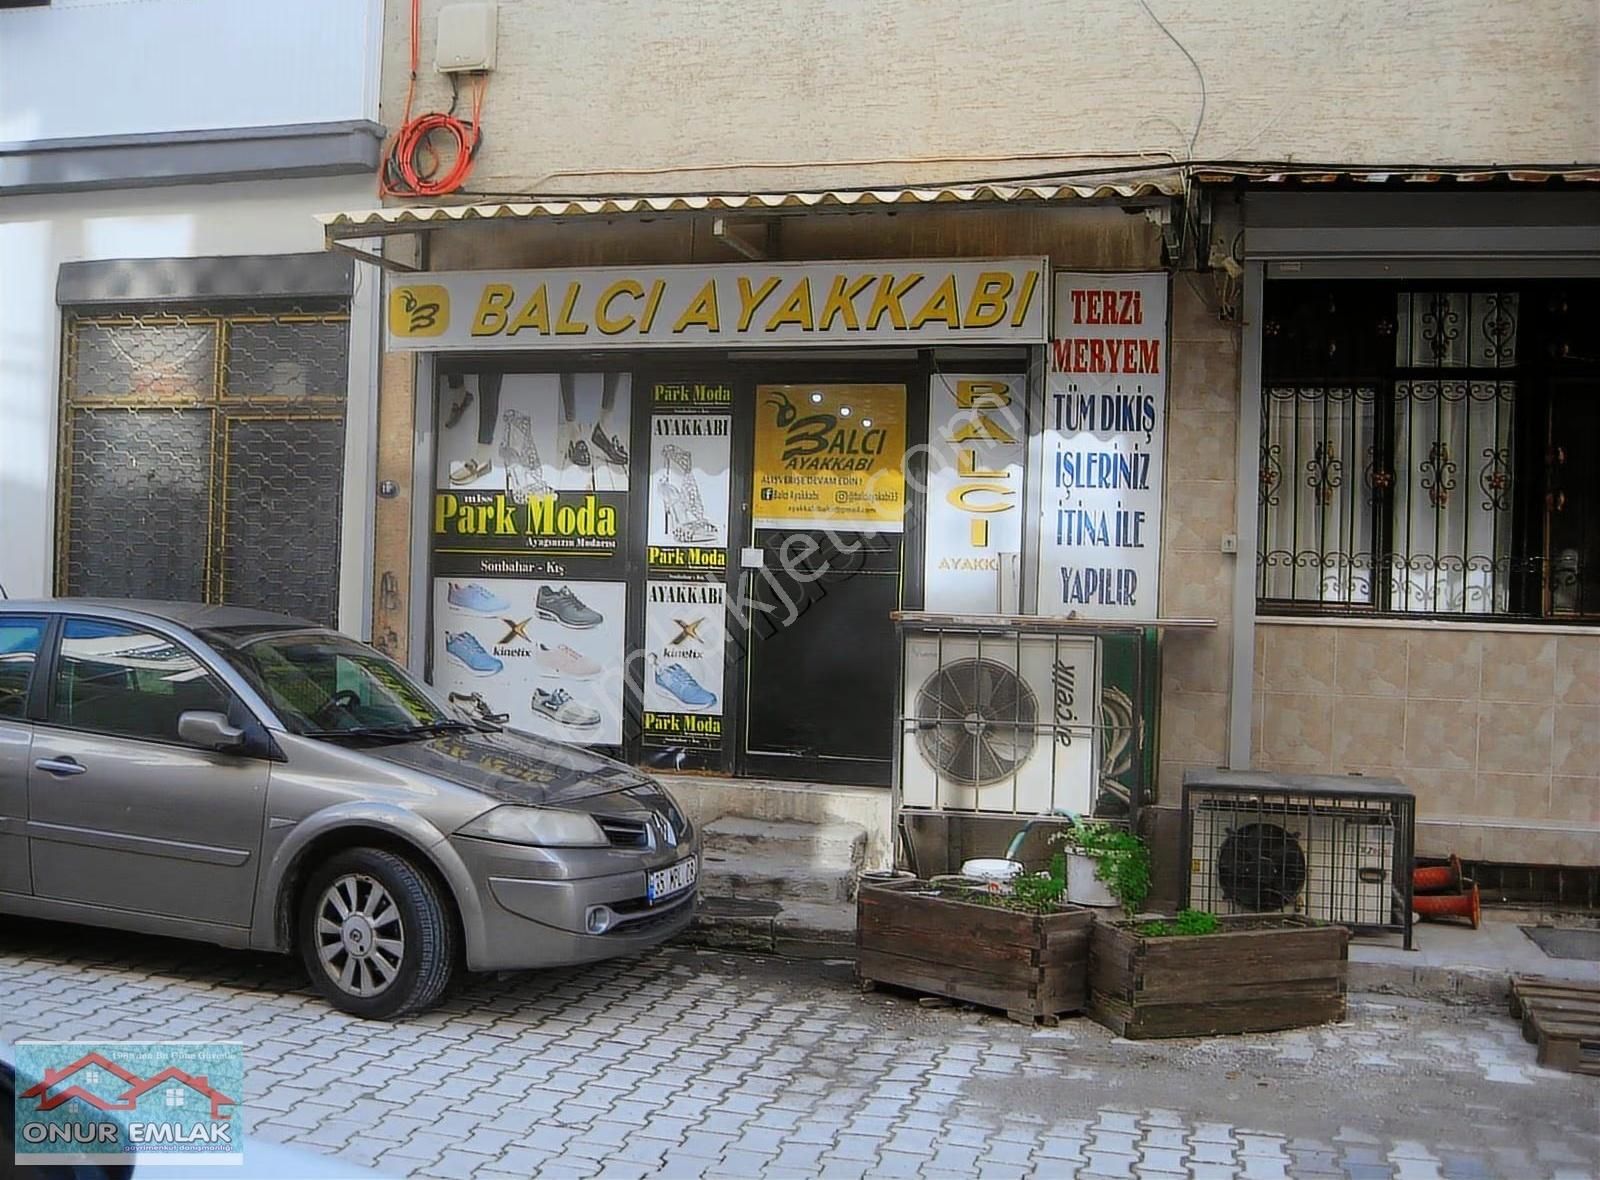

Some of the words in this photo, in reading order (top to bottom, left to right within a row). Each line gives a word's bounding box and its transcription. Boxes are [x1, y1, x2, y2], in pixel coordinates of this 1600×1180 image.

[471, 279, 667, 337] BALCI
[672, 270, 1039, 334] AYAKKABI
[1051, 339, 1160, 374] MERYEM
[654, 385, 690, 401] Park
[692, 385, 732, 401] Moda
[1053, 384, 1096, 432] TÜM
[1101, 385, 1156, 444] DİKİŞ
[654, 419, 728, 436] AYAKKABI
[782, 413, 887, 461] BALCI
[785, 457, 874, 471] AYAKKABI
[945, 380, 1018, 548] BALCI
[1055, 443, 1150, 499] İŞLERİNİZ
[464, 494, 493, 503] miss
[434, 494, 518, 535] Park
[525, 494, 616, 537] Moda
[1056, 500, 1109, 547] İTİNA
[1115, 501, 1145, 548] İLE
[649, 547, 685, 565] Park
[687, 547, 726, 567] Moda
[938, 557, 999, 571] AYAKK
[481, 560, 536, 572] Sonbahar
[546, 561, 565, 576] Kış
[650, 585, 722, 605] AYAKKABI
[1060, 567, 1138, 606] YAPILIR
[493, 646, 532, 658] kinetix
[663, 647, 704, 660] kinetix
[1052, 660, 1076, 747] arçelik
[644, 712, 680, 731] Park
[683, 714, 721, 733] Moda
